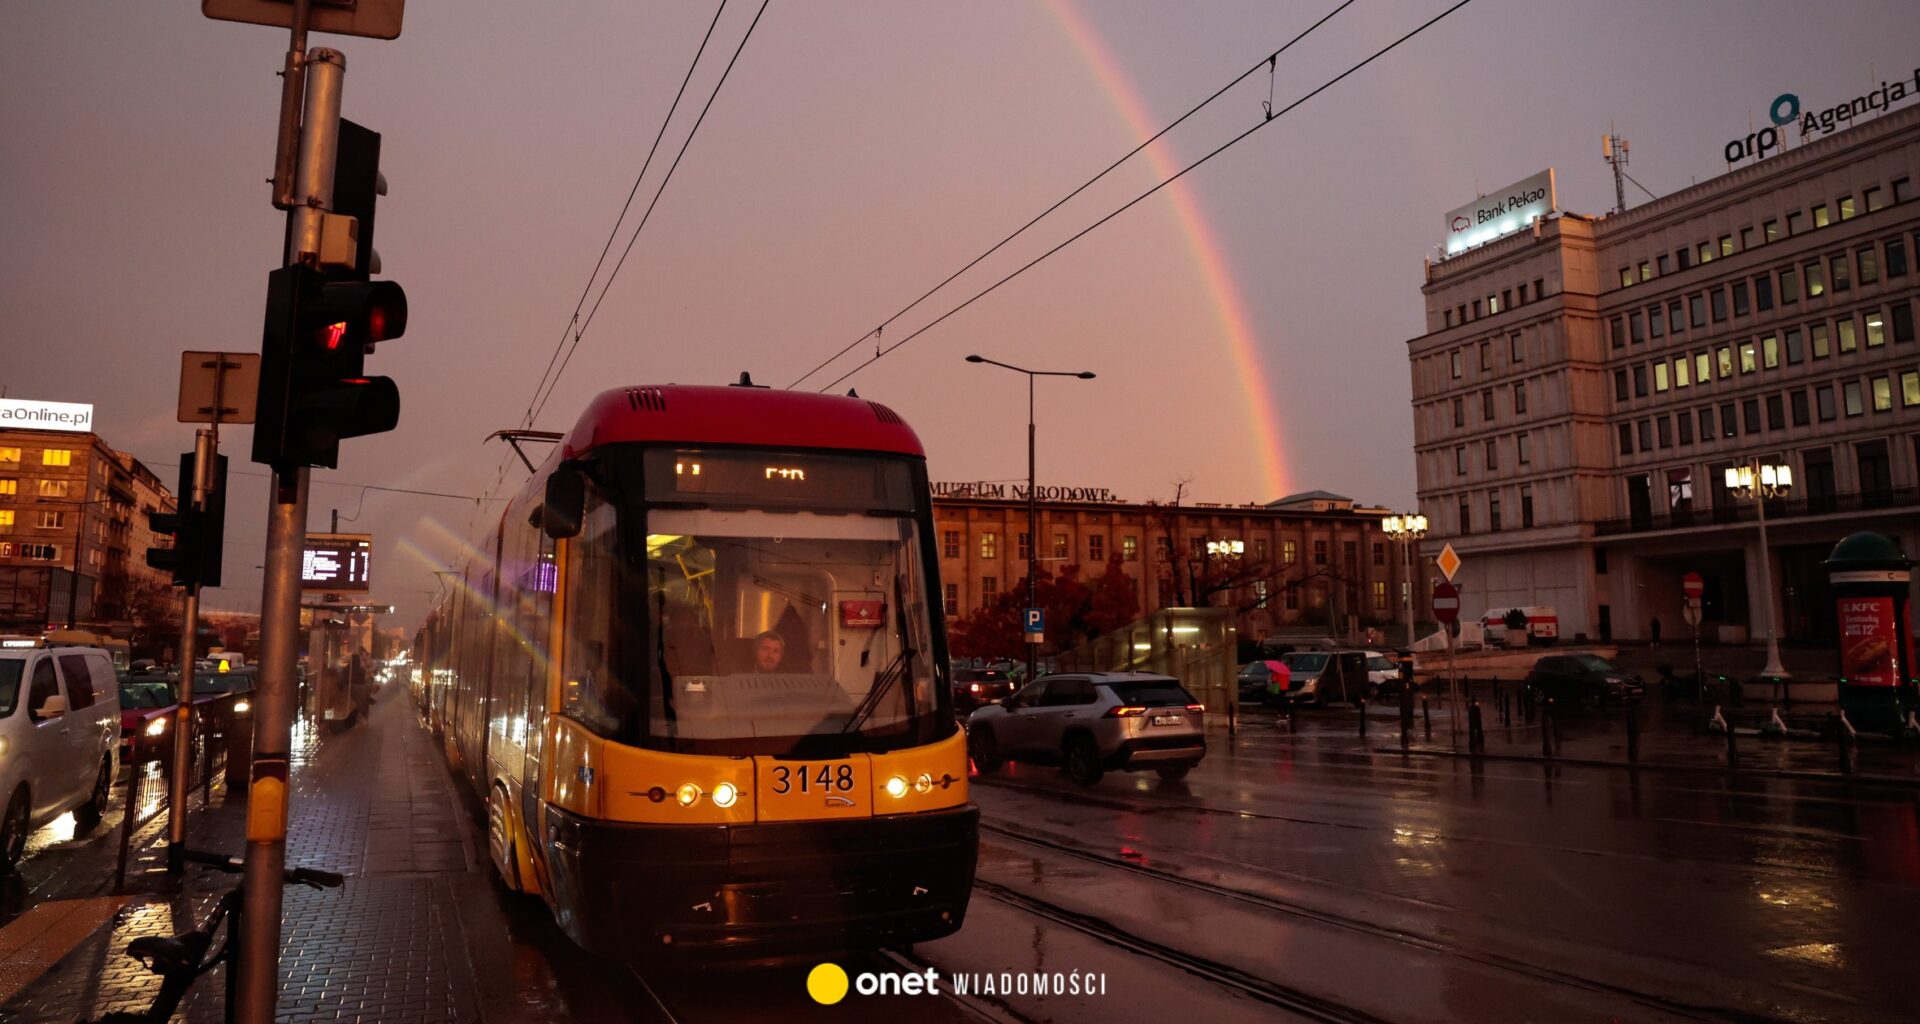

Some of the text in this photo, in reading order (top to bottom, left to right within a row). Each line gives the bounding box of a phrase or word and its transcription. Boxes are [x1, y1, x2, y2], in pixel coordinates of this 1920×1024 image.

[1801, 81, 1906, 136] Agencja
[1725, 127, 1778, 163] arp
[1477, 187, 1546, 224] Bank Pekao
[0, 407, 89, 426] aOnline.pl
[930, 481, 1005, 498] MUZEUM
[1028, 610, 1040, 626] P
[1851, 602, 1880, 613] KFC
[772, 764, 854, 794] 3148
